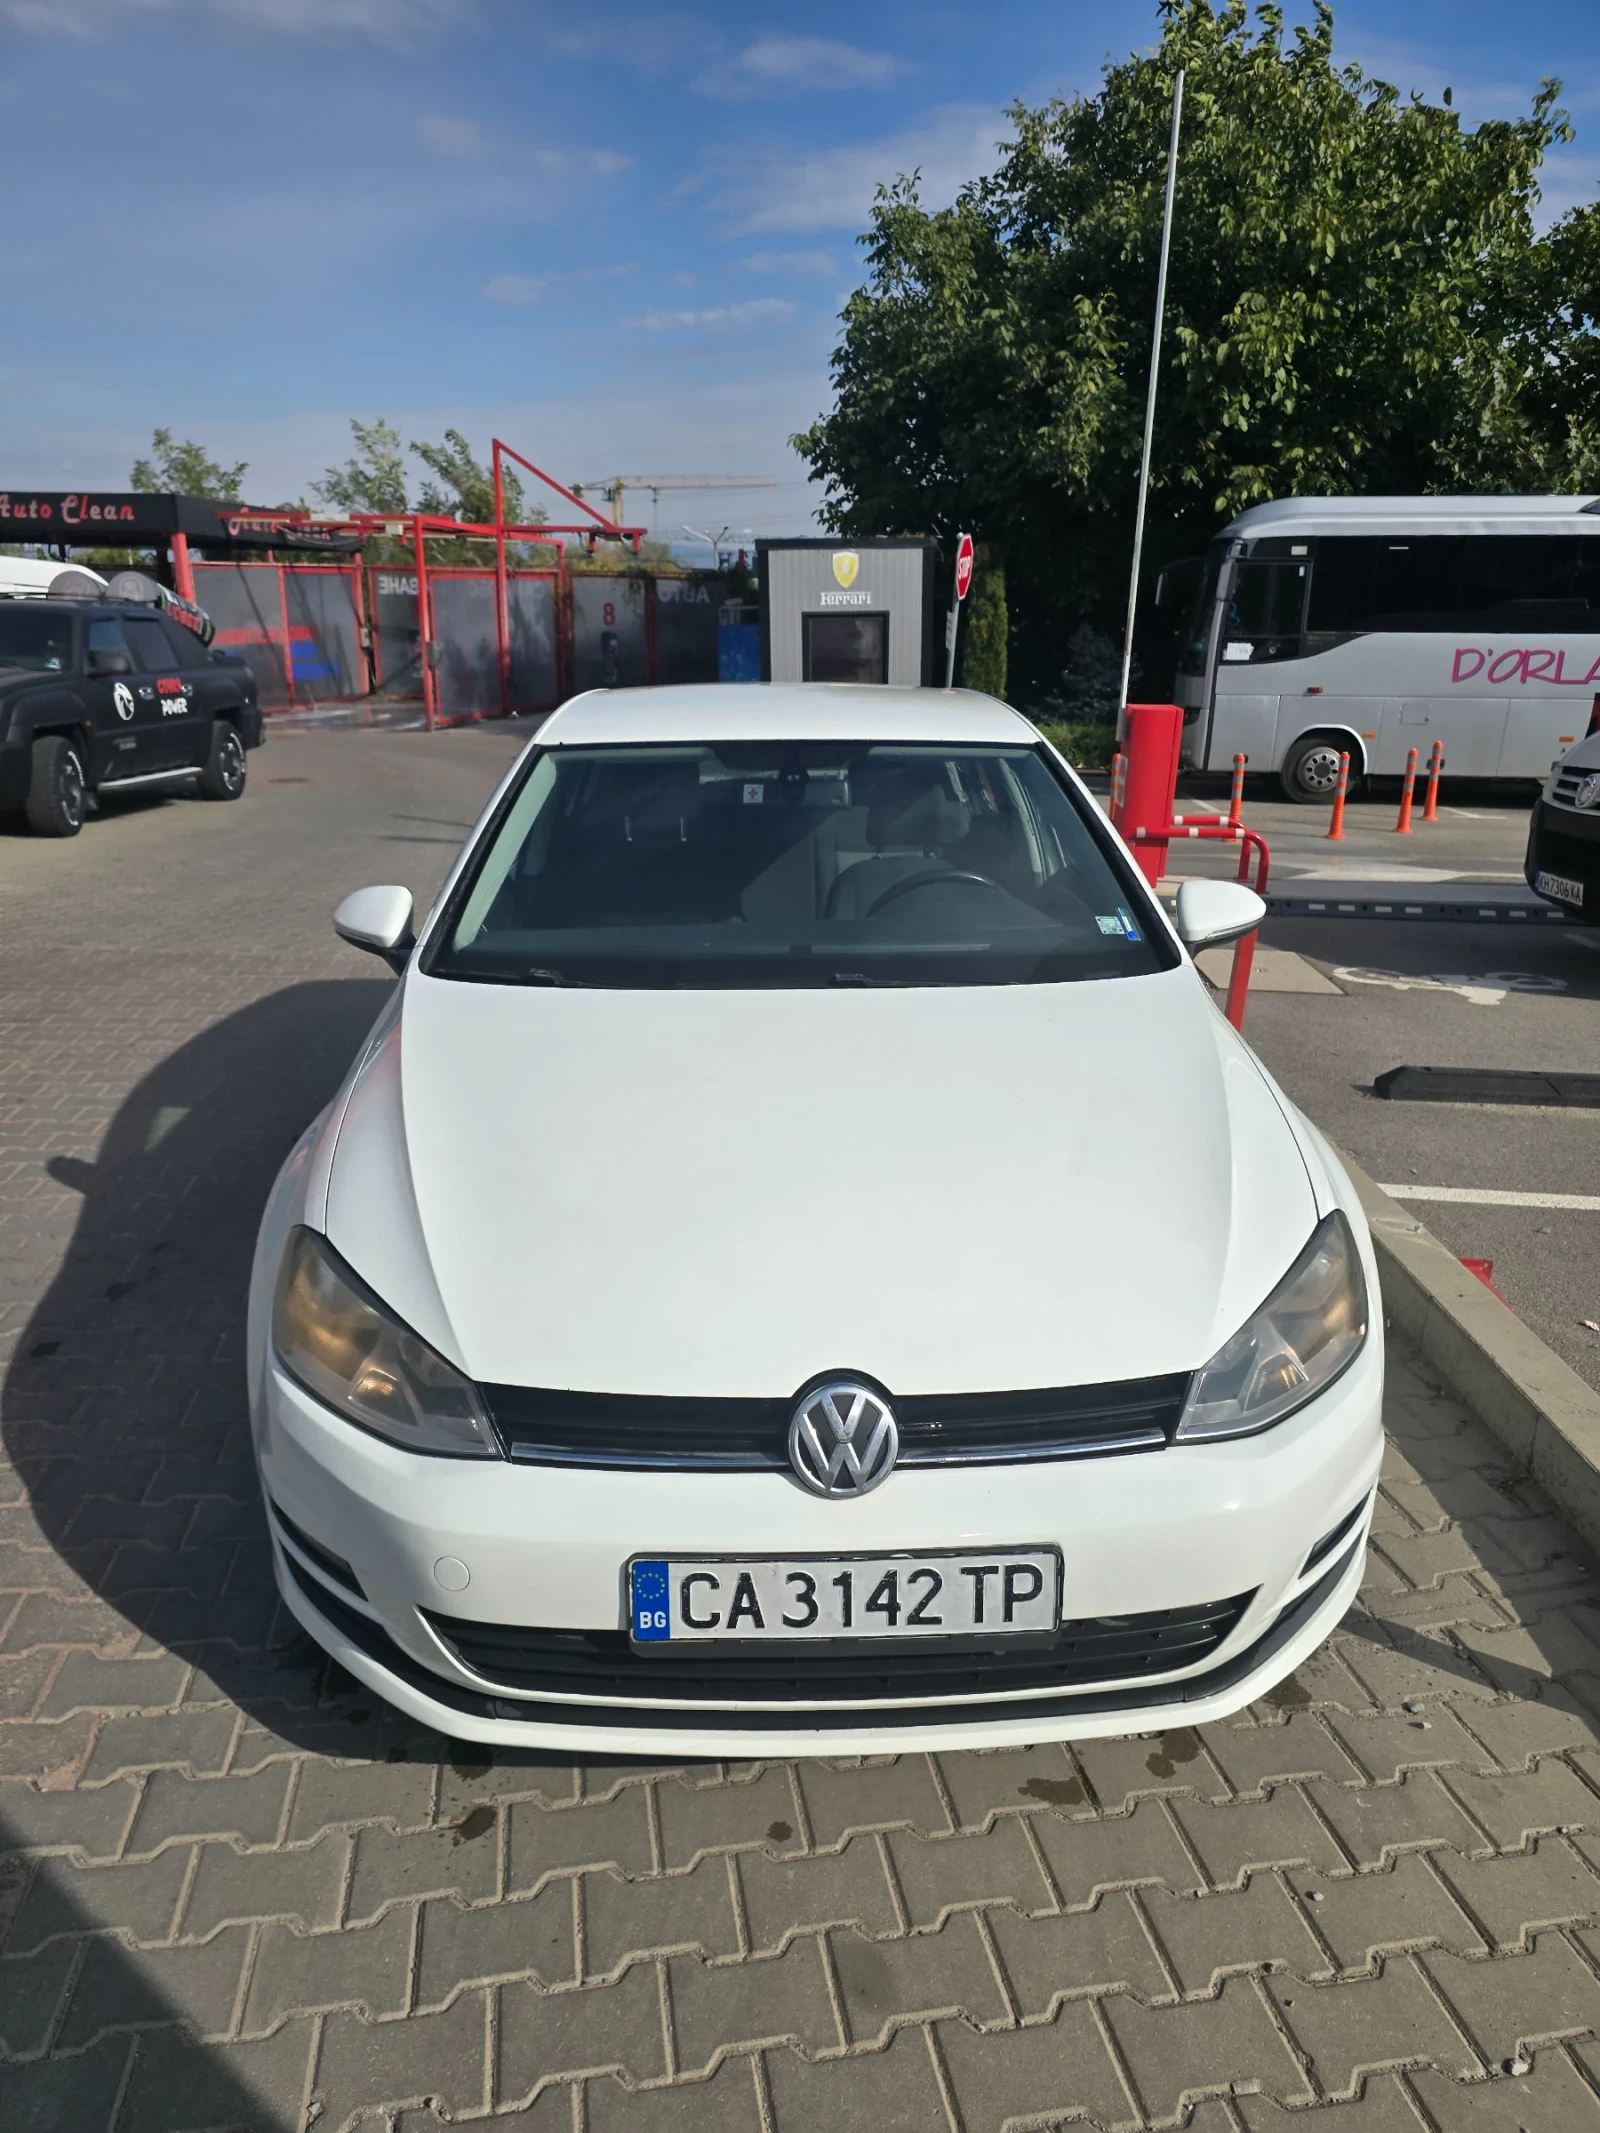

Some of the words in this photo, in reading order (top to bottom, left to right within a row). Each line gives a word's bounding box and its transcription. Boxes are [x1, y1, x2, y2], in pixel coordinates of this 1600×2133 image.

[60, 494, 135, 524] Clean
[958, 555, 971, 580] STOP
[820, 591, 871, 605] Ferrari
[603, 602, 616, 626] 8
[1550, 878, 1569, 898] 7306
[680, 1571, 766, 1630] CA
[781, 1567, 943, 1629] 3142
[959, 1563, 1044, 1624] TP
[639, 1611, 667, 1629] BG
